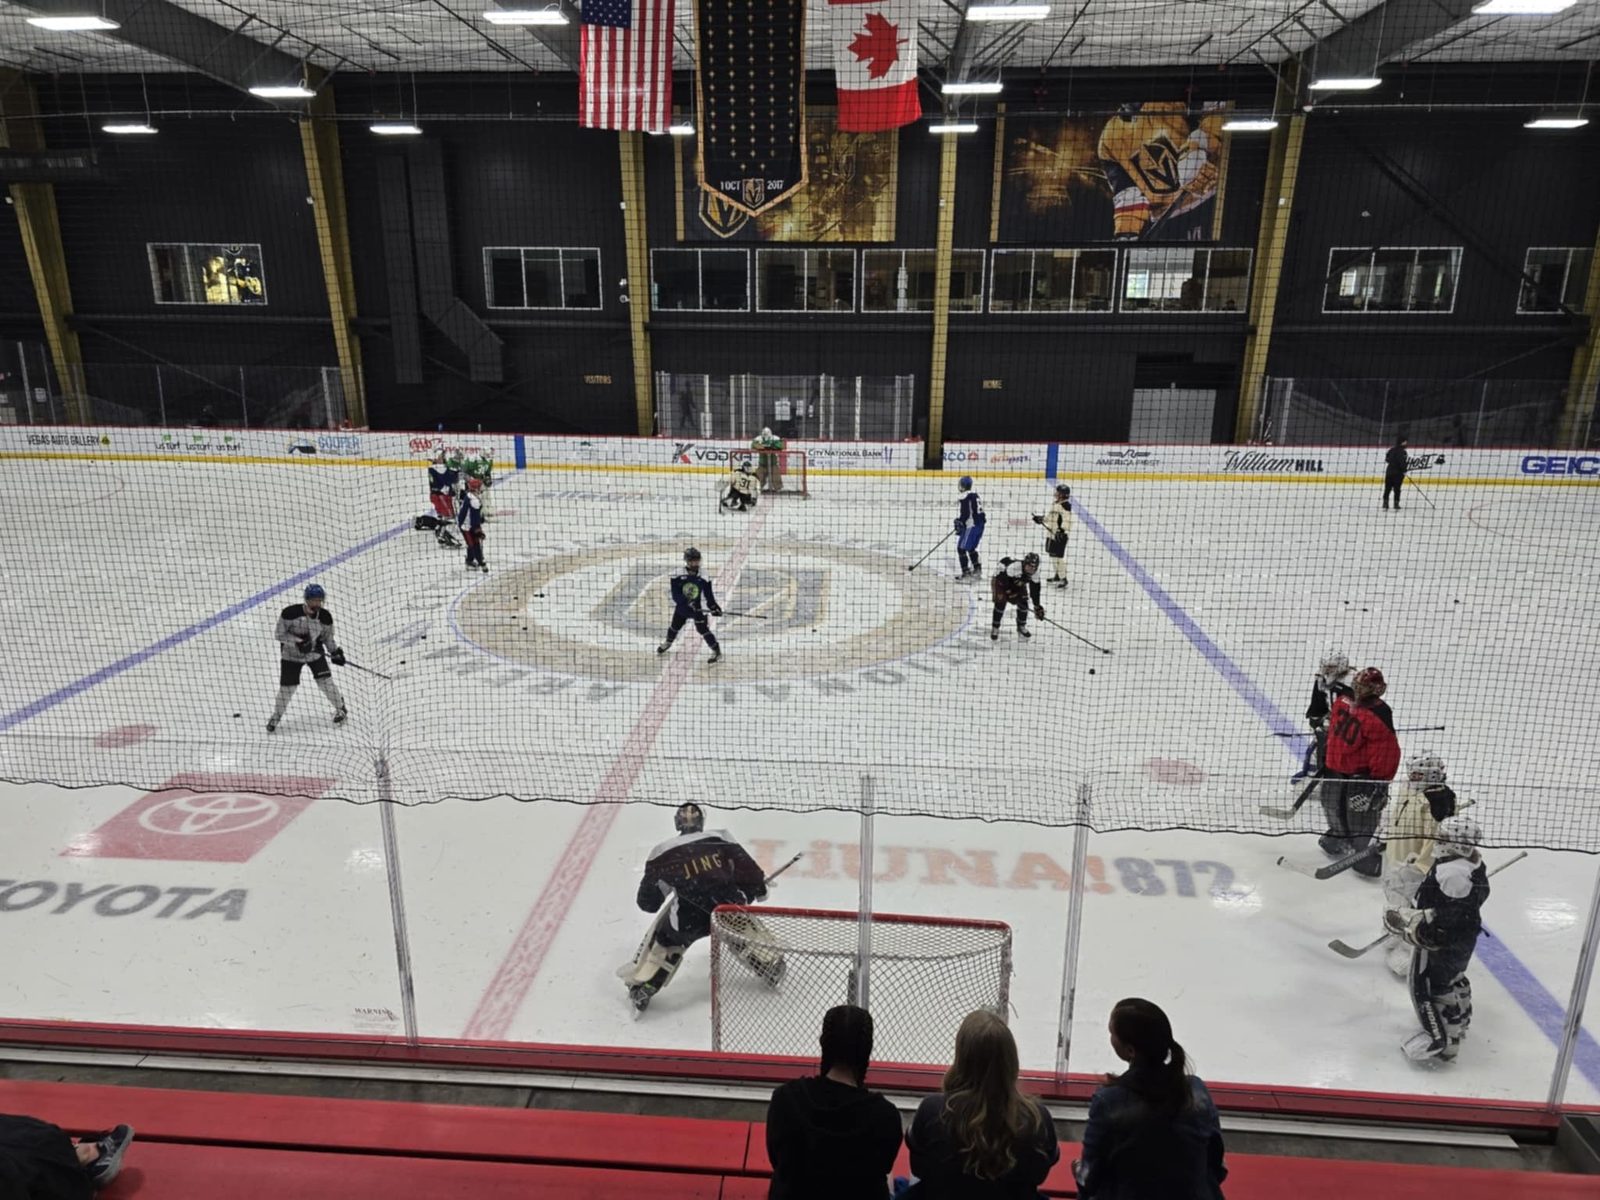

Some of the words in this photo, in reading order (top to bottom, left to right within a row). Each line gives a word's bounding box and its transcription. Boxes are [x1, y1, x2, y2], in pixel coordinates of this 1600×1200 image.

[725, 181, 741, 191] OCT
[767, 180, 784, 190] 2017
[27, 435, 50, 446] VEGAS
[51, 435, 69, 446] AUTO
[70, 435, 100, 446] GALLERY
[695, 450, 752, 461] VODKA
[808, 449, 823, 457] CITY
[825, 449, 860, 457] NATIONAL
[862, 449, 882, 457] BANK
[1223, 450, 1294, 471] William
[1295, 459, 1324, 472] HILL
[1406, 453, 1437, 470] HOST
